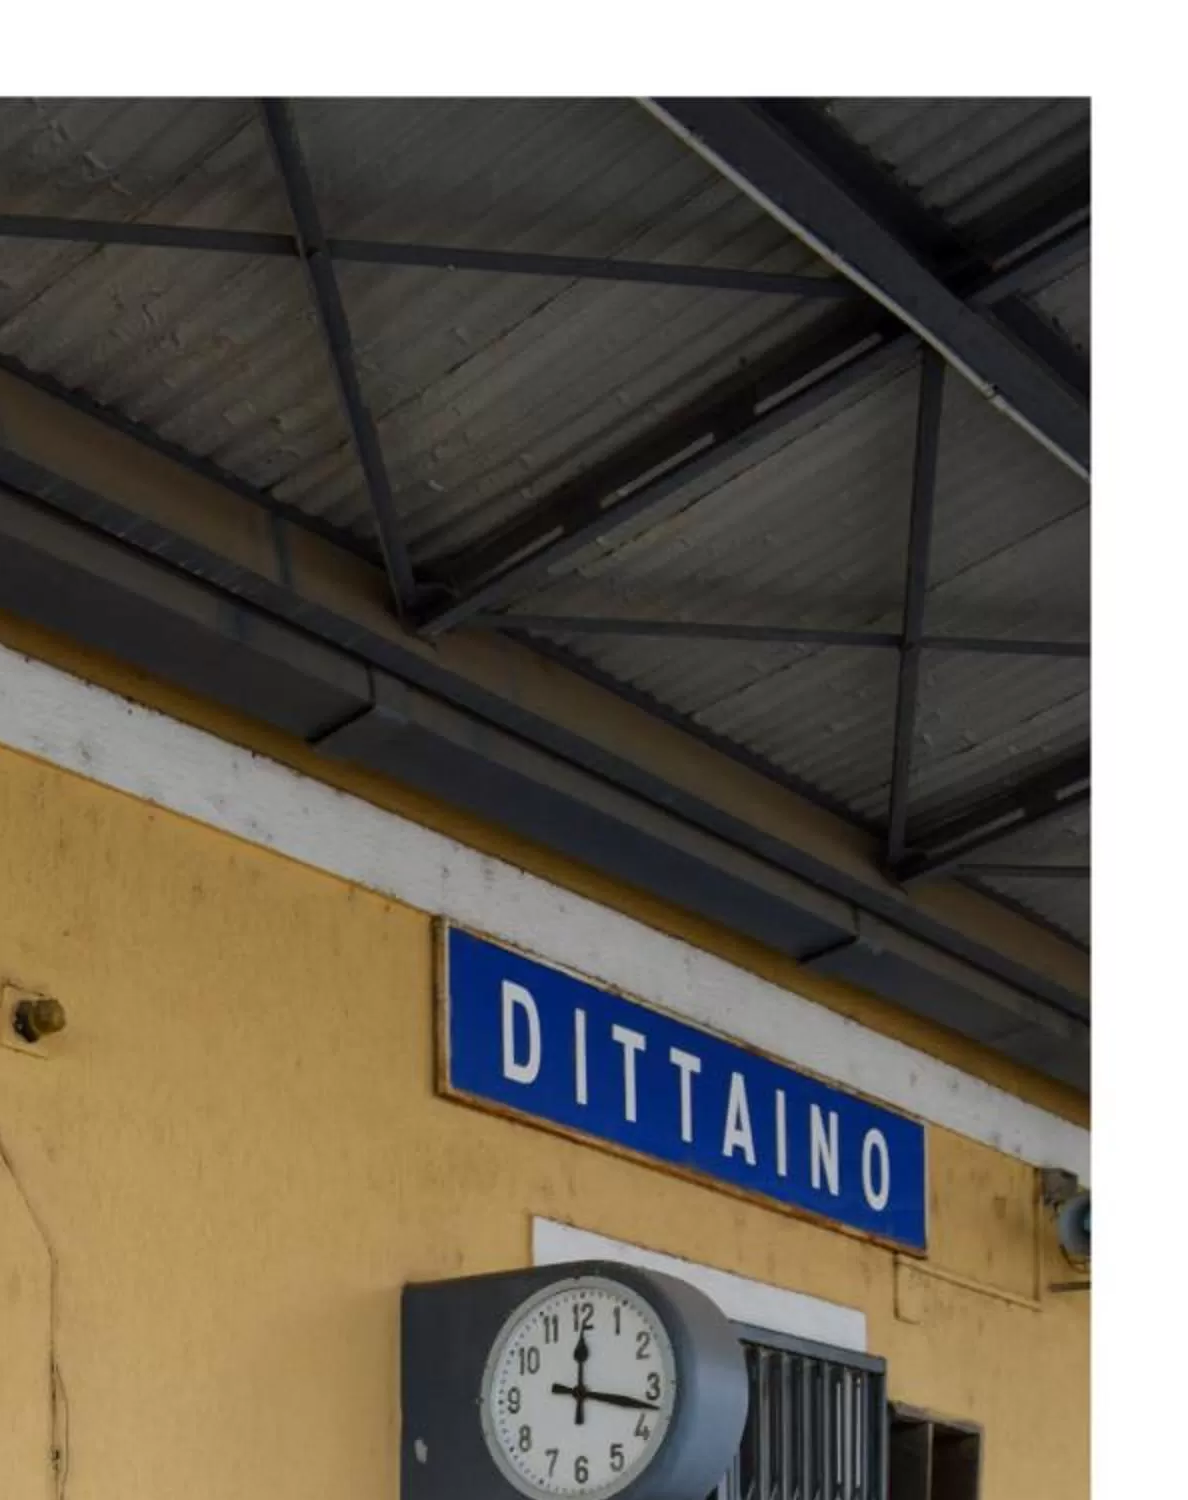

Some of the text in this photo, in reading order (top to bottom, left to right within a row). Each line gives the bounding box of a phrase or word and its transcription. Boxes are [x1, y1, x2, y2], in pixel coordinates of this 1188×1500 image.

[500, 979, 891, 1211] DITTAINO
[542, 1314, 559, 1344] 11
[571, 1302, 595, 1332] 12
[612, 1305, 621, 1336] 1
[635, 1331, 651, 1360] 2
[518, 1346, 541, 1376] 10
[507, 1386, 521, 1415] 9
[645, 1372, 661, 1400] 3
[518, 1424, 533, 1452] 8
[633, 1413, 650, 1440] 4
[545, 1448, 559, 1477] 7
[574, 1455, 589, 1483] 6
[609, 1443, 624, 1471] 5
